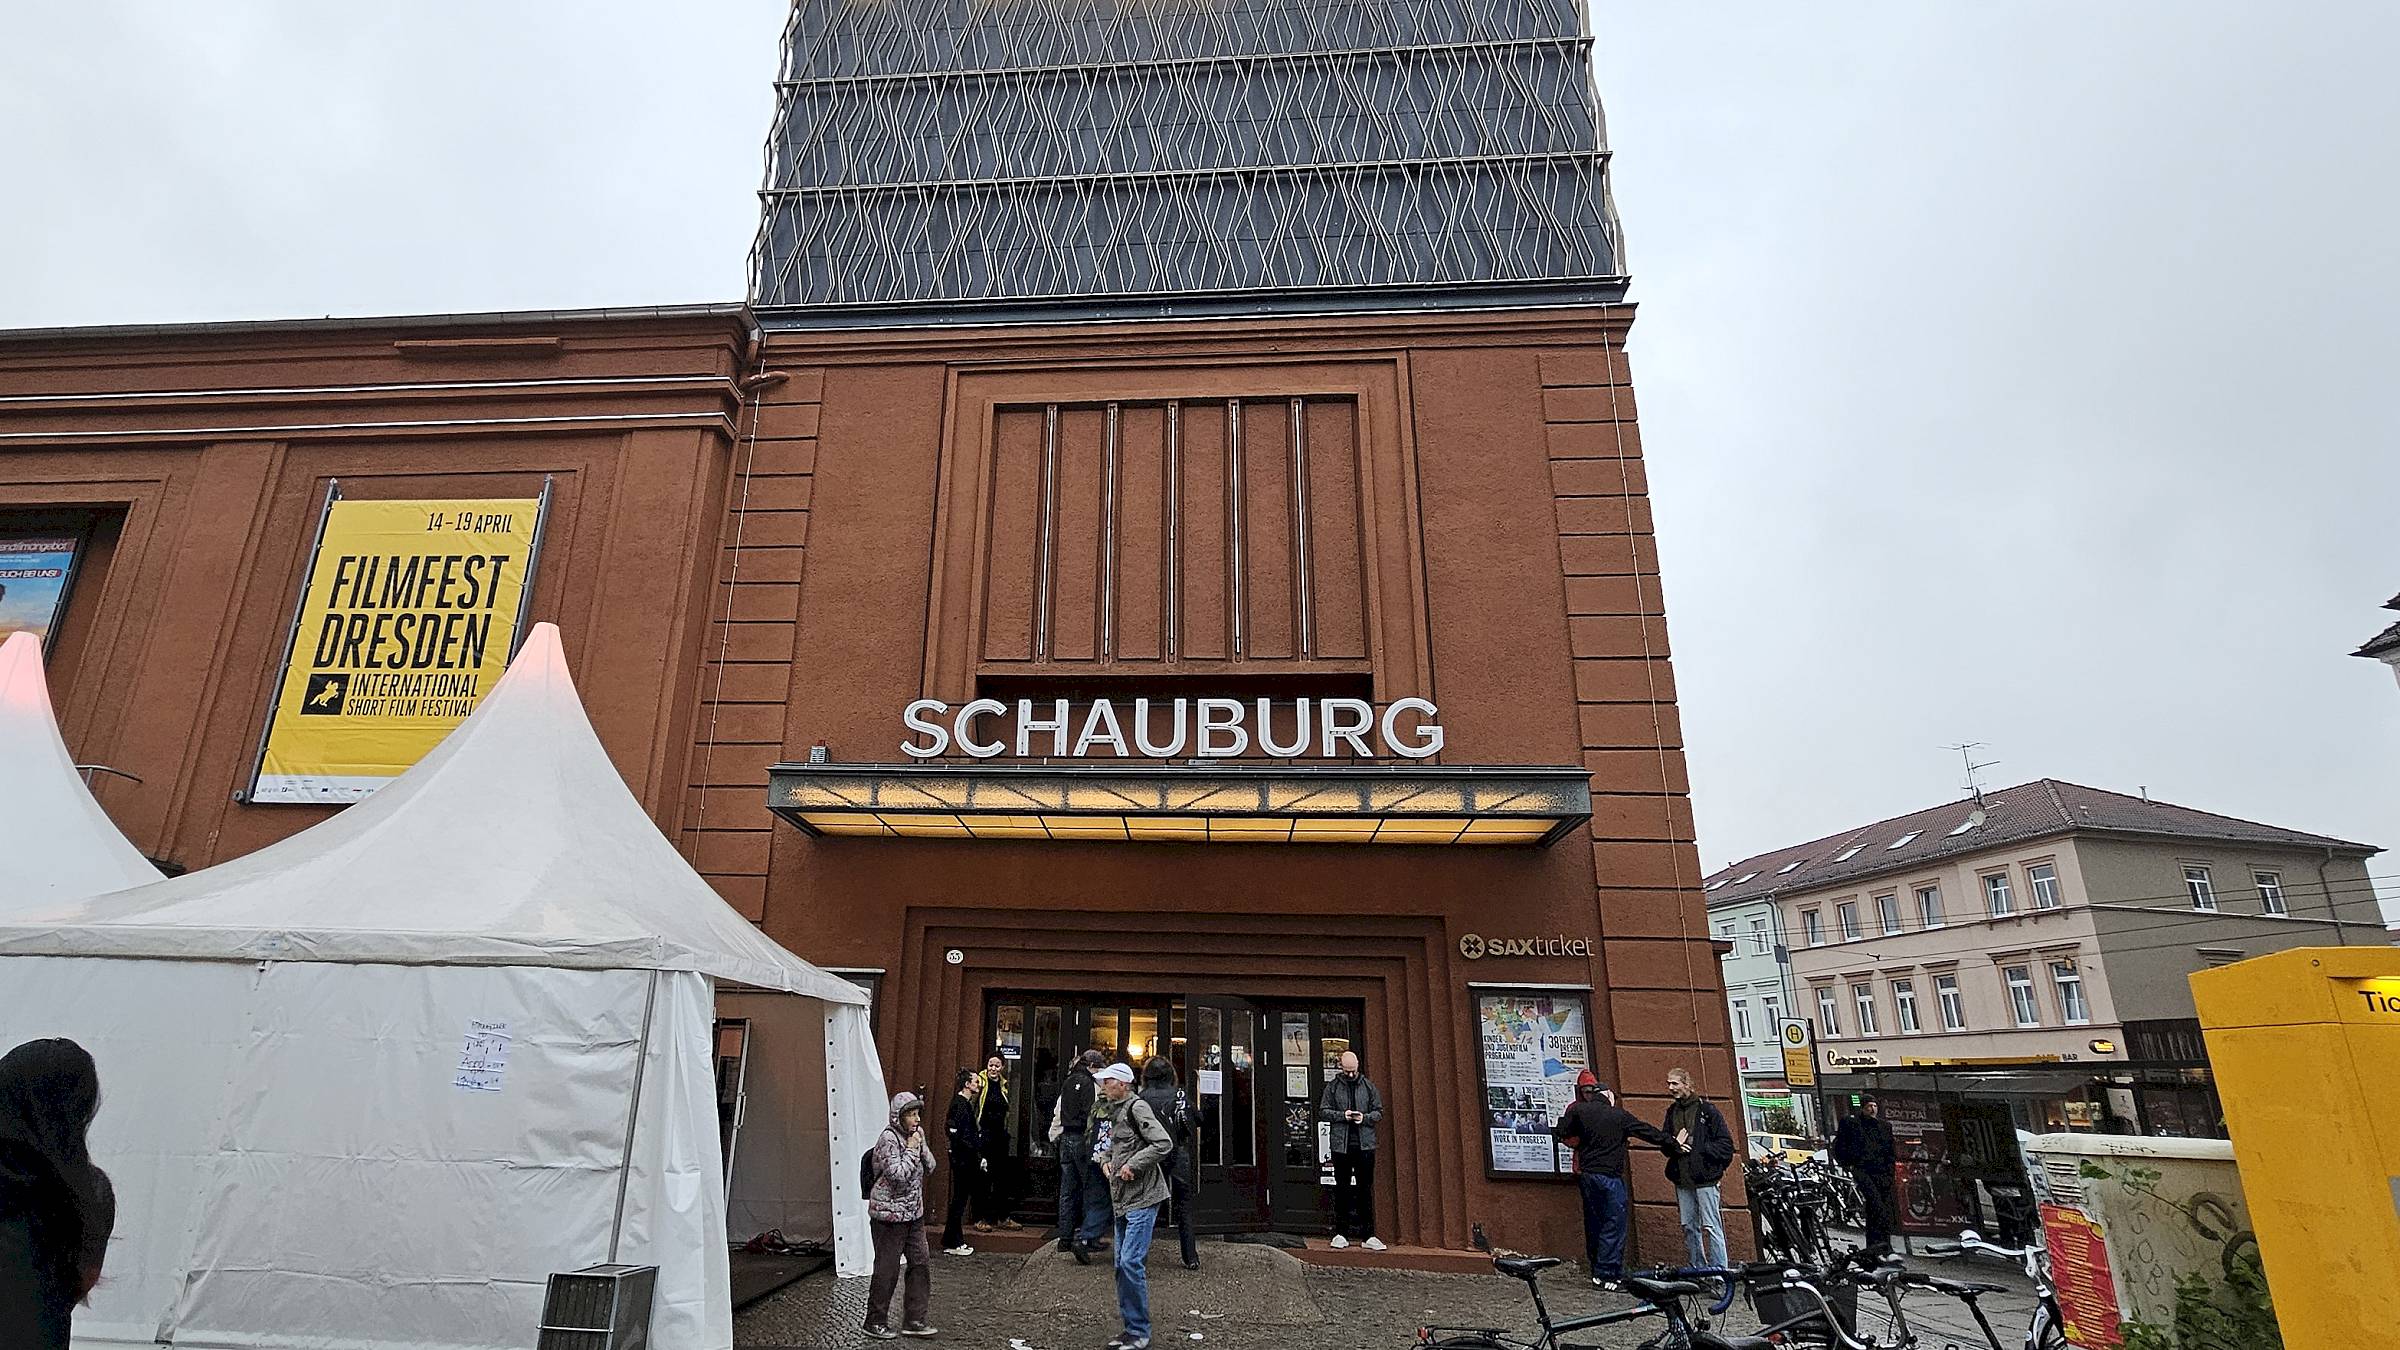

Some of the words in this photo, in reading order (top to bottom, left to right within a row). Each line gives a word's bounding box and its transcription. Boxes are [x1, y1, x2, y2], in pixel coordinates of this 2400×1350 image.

[474, 514, 512, 533] APRIL
[328, 554, 509, 609] FILMFEST
[312, 613, 491, 669] DRESDEN
[351, 673, 478, 698] INTERNATIONAL
[346, 698, 384, 716] SHORT
[388, 699, 416, 716] FILM
[420, 700, 473, 717] FESTIVAL
[900, 697, 1444, 760] SCHAUBURG
[1487, 933, 1595, 957] SAXticket
[2358, 990, 2400, 1012] Tic
[1483, 1034, 1503, 1042] KINDER
[1548, 1035, 1560, 1049] 38
[1559, 1035, 1582, 1044] FILMFEST
[1484, 1043, 1495, 1051] UND
[1560, 1044, 1583, 1053] DRESDEN
[1485, 1051, 1516, 1060] PROGRAMM
[2062, 1053, 2079, 1061] BAR
[1493, 1134, 1510, 1143] WORK
[1519, 1135, 1547, 1144] PROGRESS
[1951, 1215, 1972, 1223] XXL
